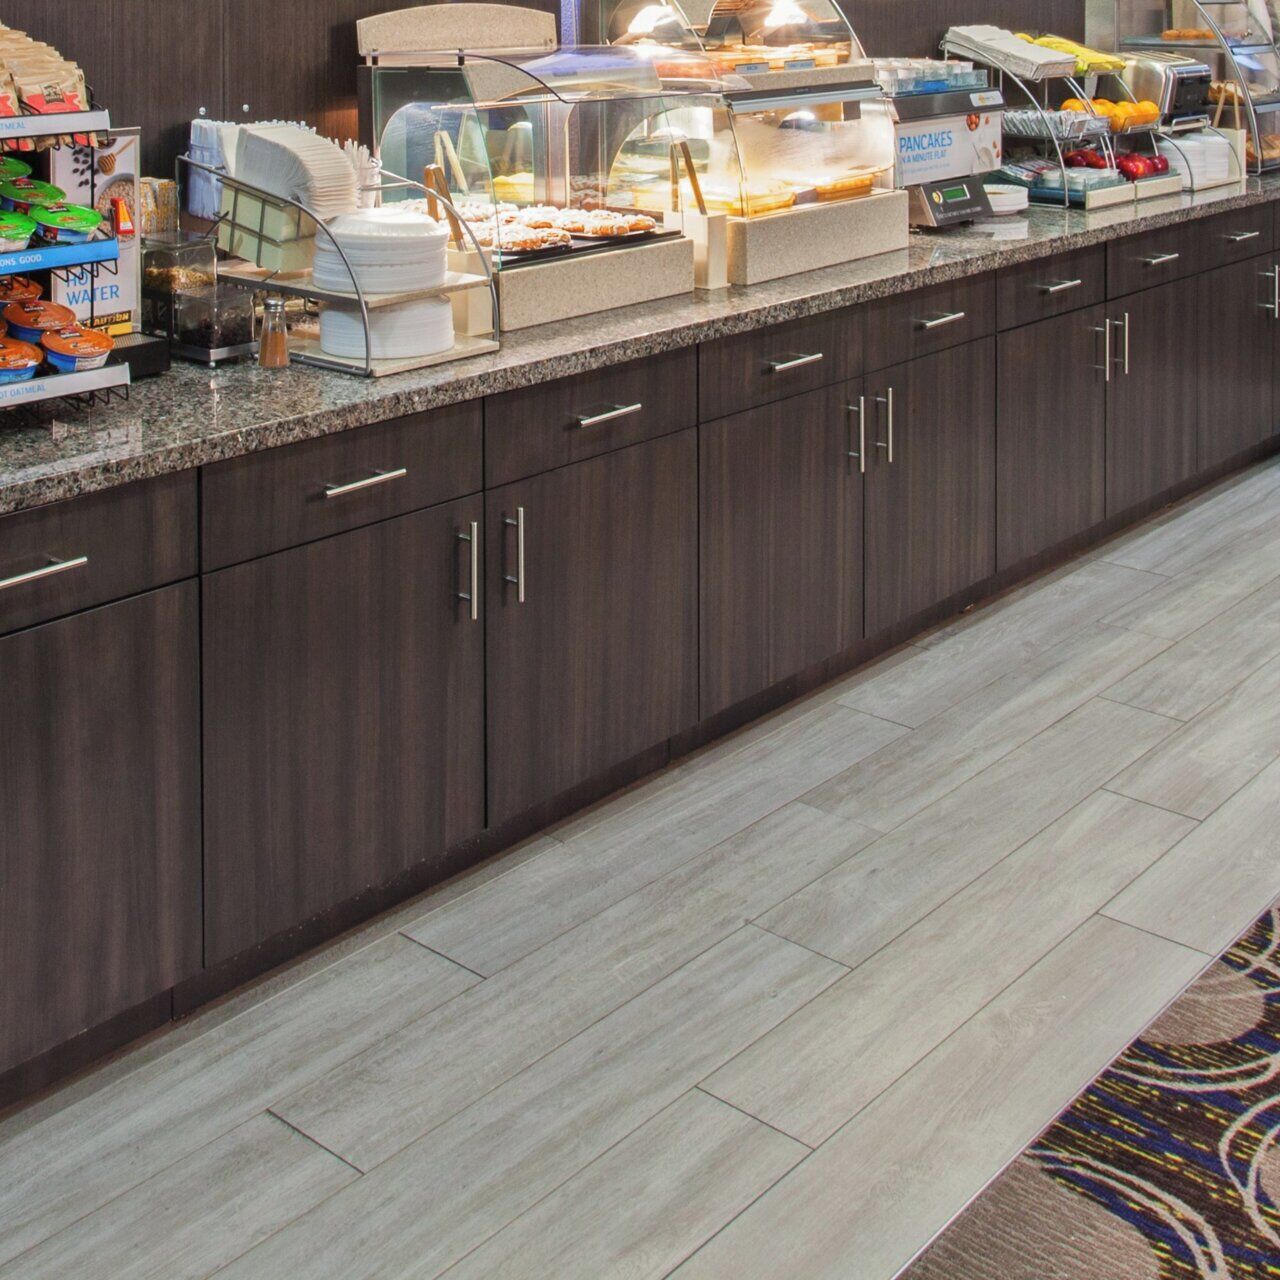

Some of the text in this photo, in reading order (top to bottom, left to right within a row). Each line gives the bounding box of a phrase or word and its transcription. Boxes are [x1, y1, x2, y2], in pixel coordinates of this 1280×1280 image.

[900, 130, 953, 153] PANCAKES
[66, 284, 120, 306] WATER
[86, 311, 130, 327] AUTION
[9, 384, 46, 398] OATMEAL
